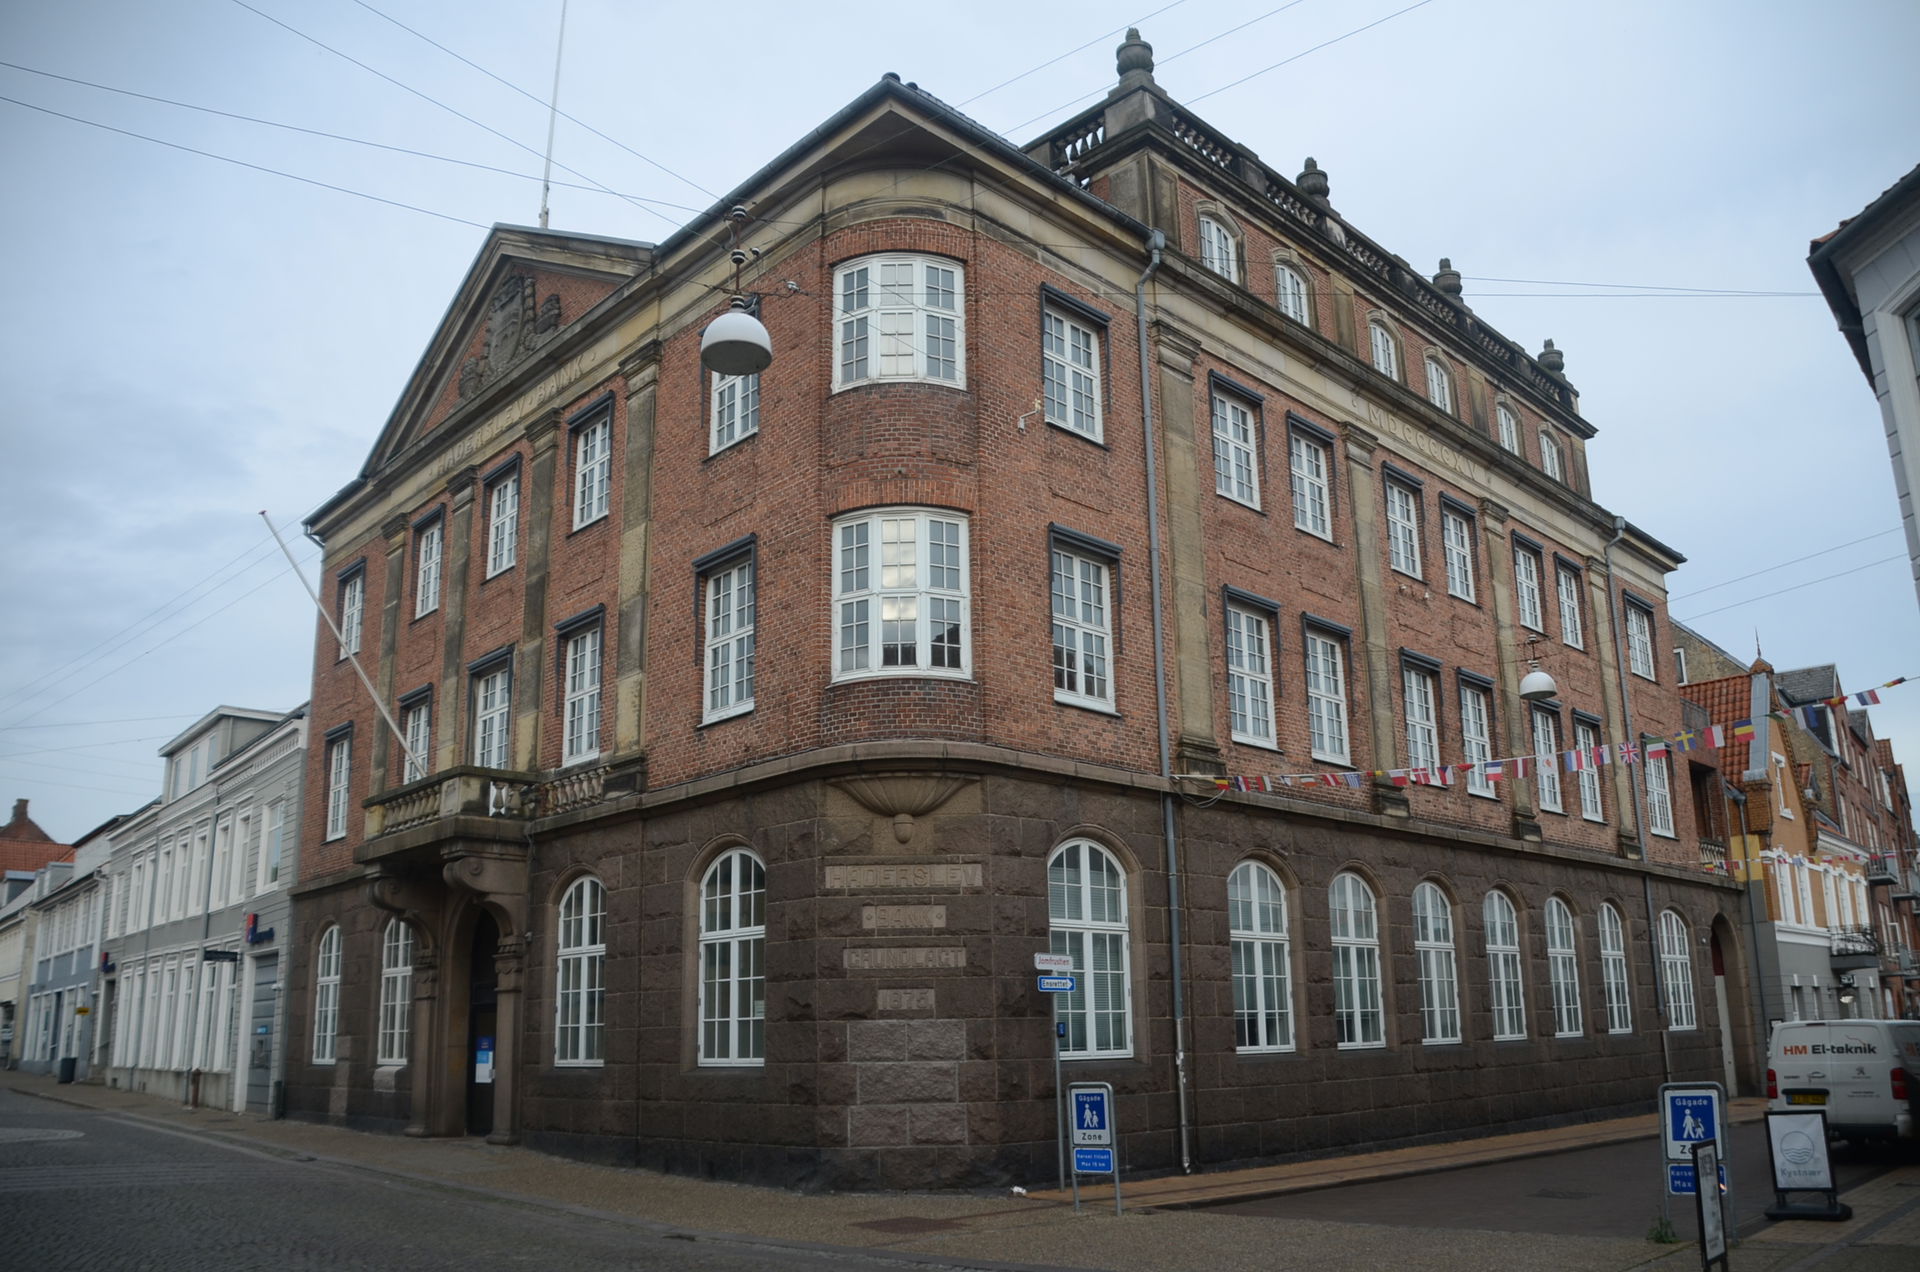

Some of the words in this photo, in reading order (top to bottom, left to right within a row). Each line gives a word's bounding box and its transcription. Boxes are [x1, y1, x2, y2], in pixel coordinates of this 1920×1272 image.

[537, 353, 585, 404] BANK
[829, 865, 978, 888] HADERSLEV
[876, 907, 933, 928] BANK
[847, 950, 963, 968] GRUNDLAGT
[1042, 979, 1069, 988] Ensrettet
[1783, 1045, 1808, 1055] HM
[1811, 1043, 1877, 1055] El-teknik
[1675, 1098, 1708, 1107] Gågade
[1081, 1132, 1103, 1141] Zone
